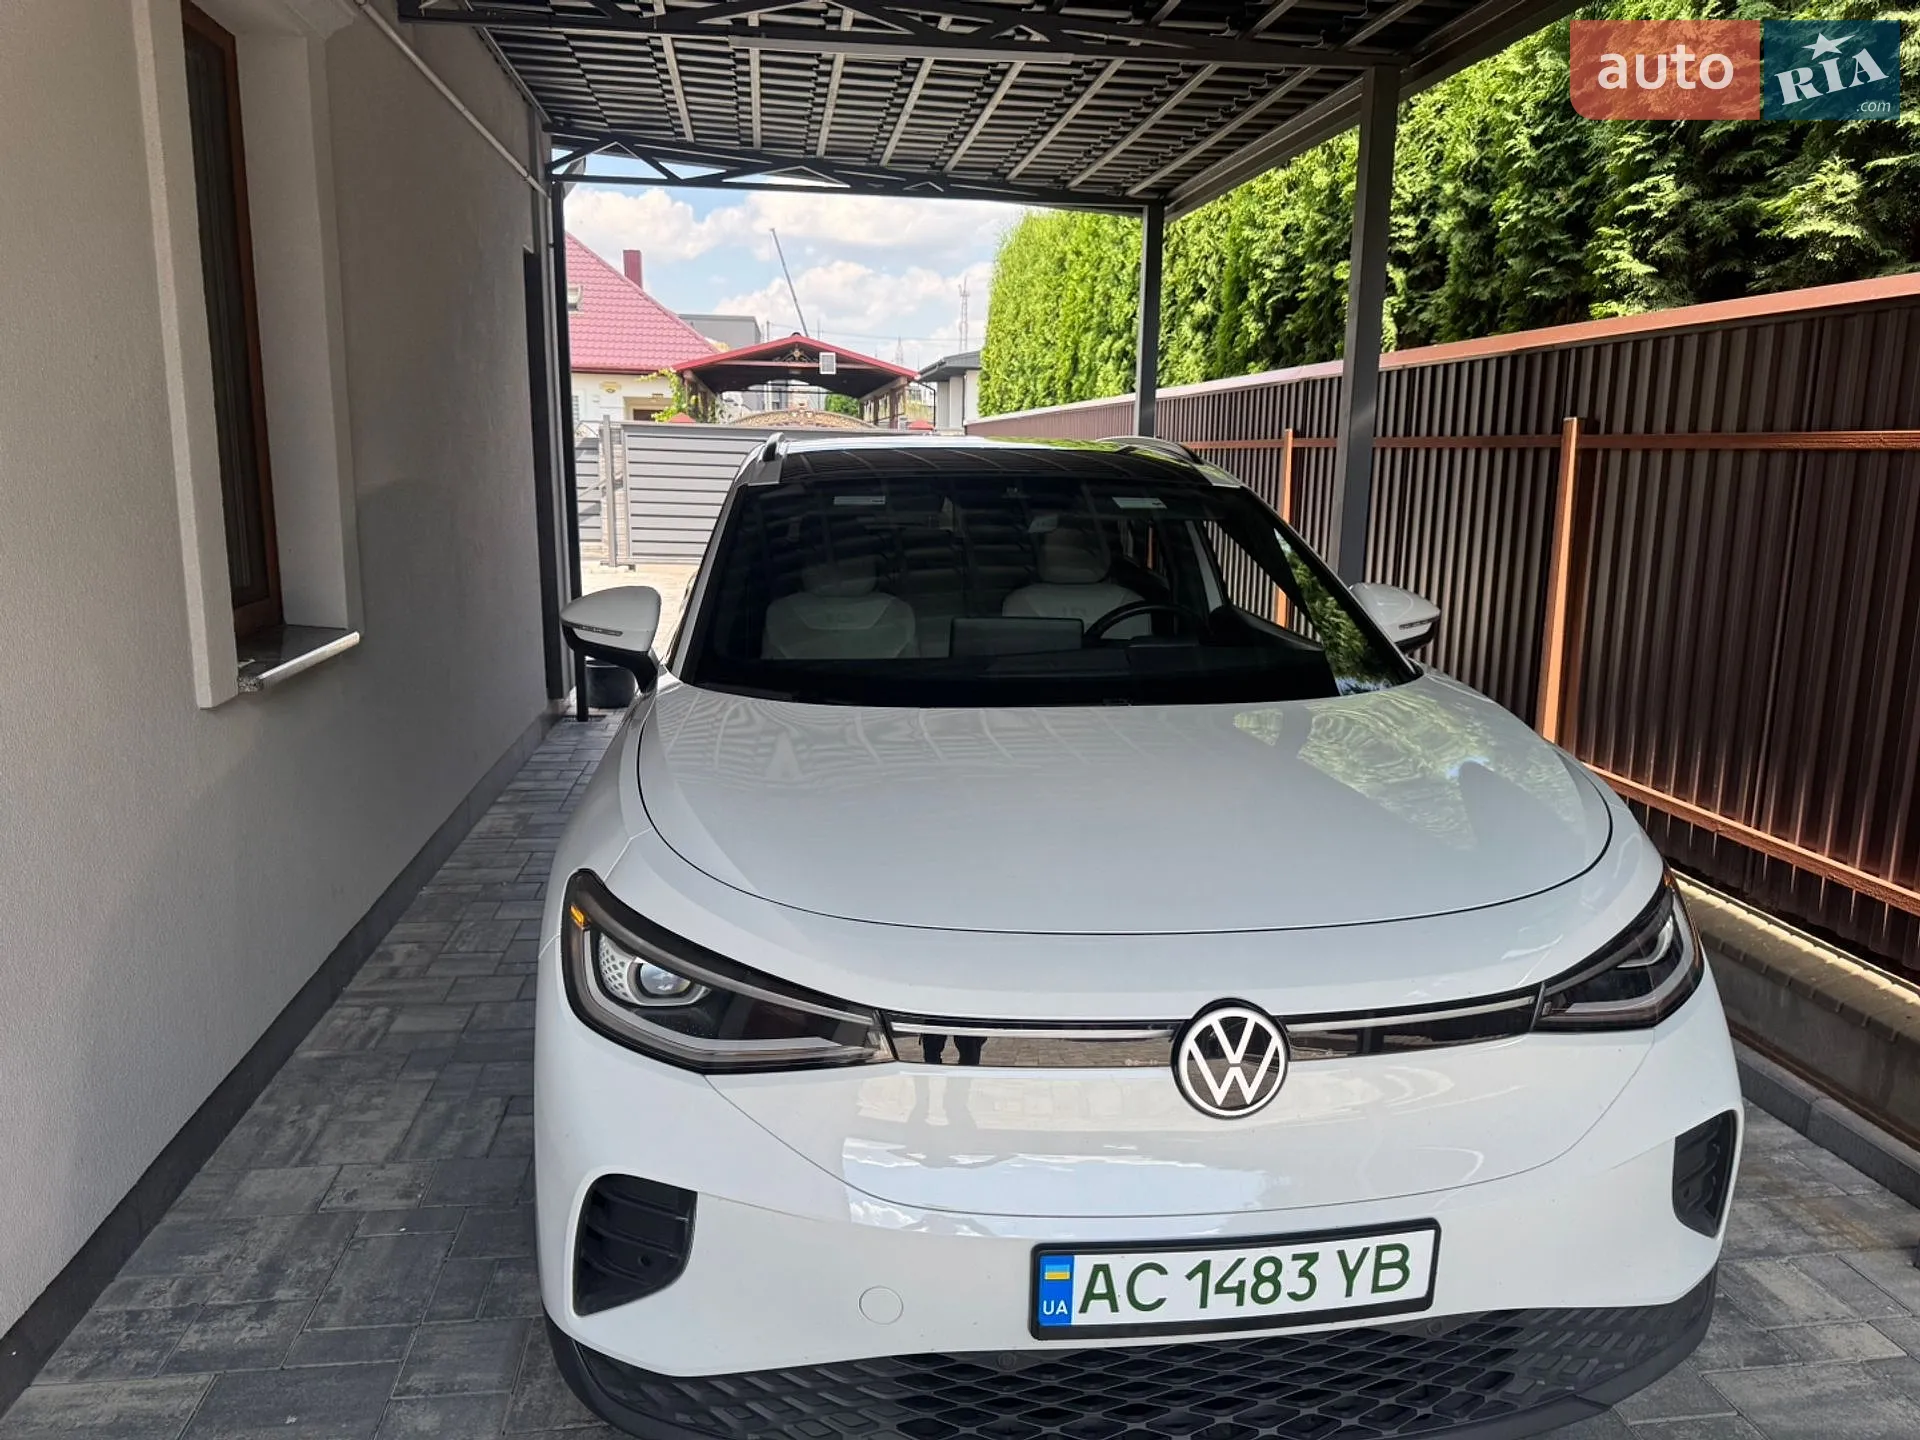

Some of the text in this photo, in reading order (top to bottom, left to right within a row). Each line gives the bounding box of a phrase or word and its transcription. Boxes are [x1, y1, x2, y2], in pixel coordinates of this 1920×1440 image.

[1187, 1015, 1279, 1107] VW
[1043, 1299, 1068, 1316] UA
[1078, 1243, 1411, 1314] AC 1483 YB
